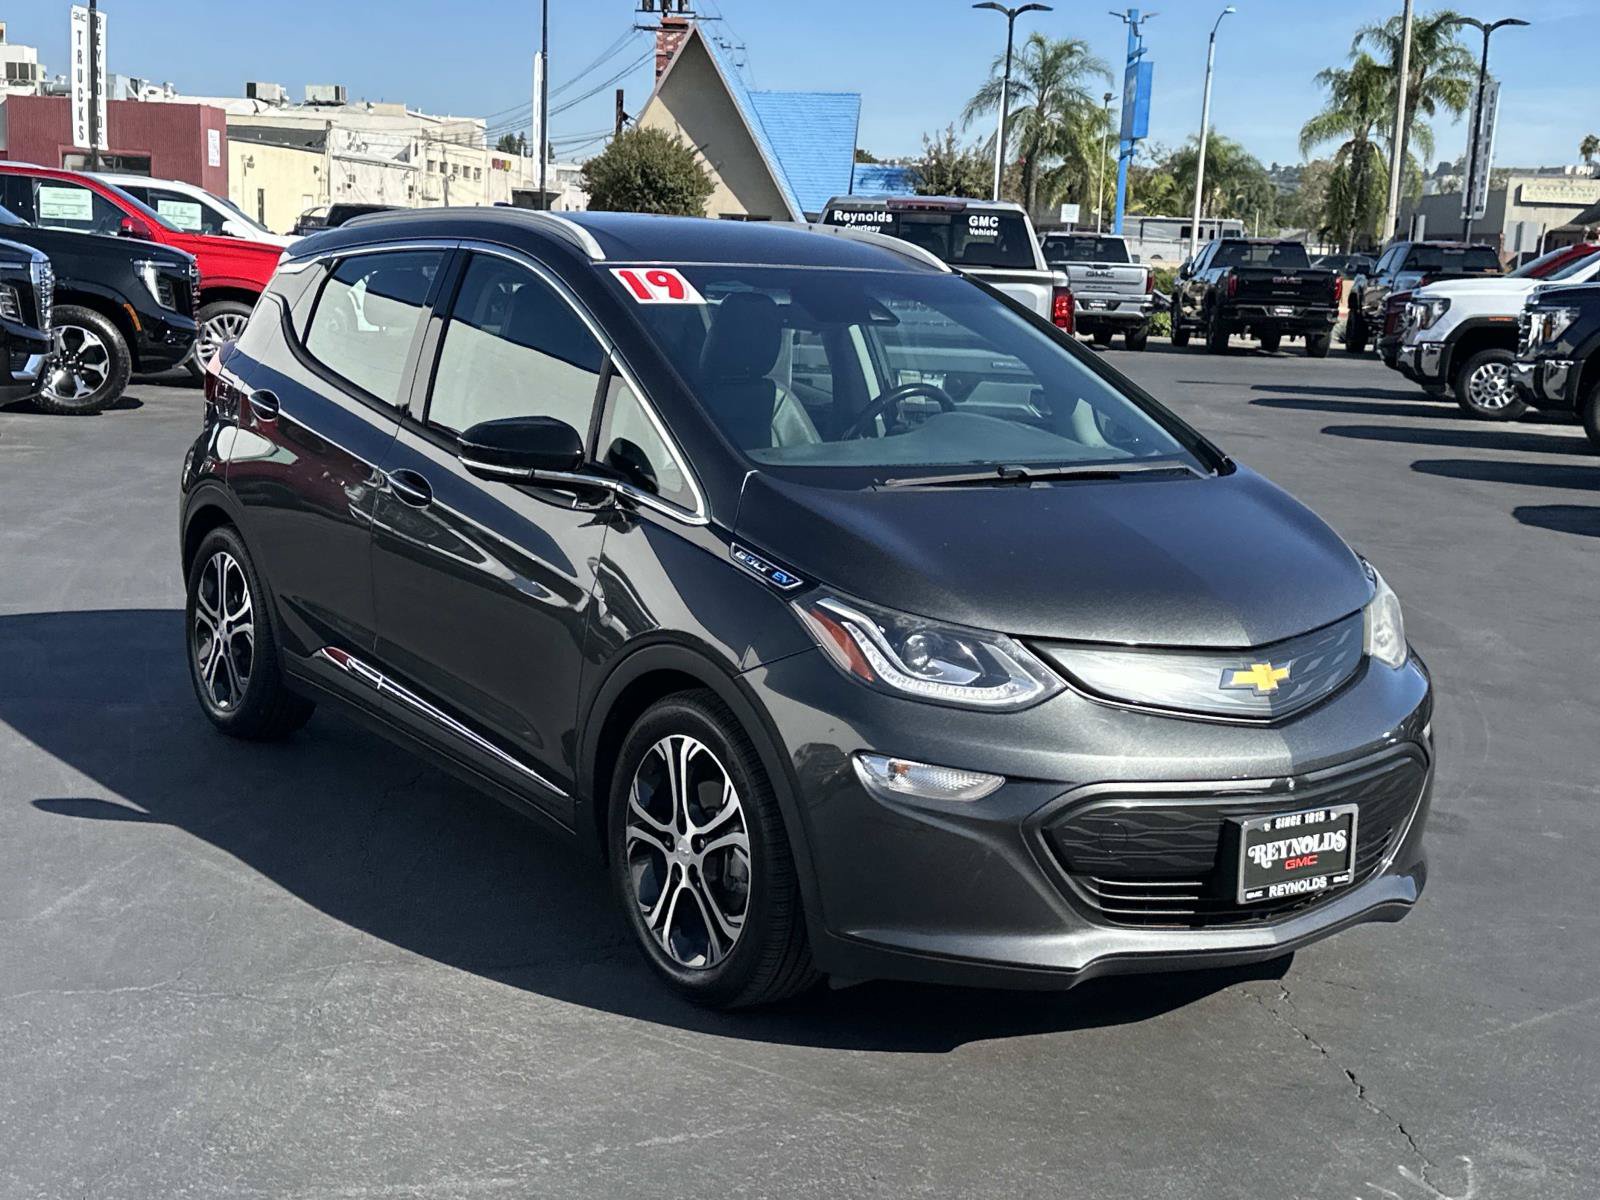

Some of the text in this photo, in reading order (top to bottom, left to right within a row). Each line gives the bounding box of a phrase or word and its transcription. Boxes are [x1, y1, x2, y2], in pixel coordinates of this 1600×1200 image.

[76, 30, 84, 141] TRUCKS
[833, 210, 893, 223] Reynolds
[968, 215, 999, 228] GMC
[844, 223, 881, 233] Courtesy
[969, 228, 998, 236] Vehicle
[618, 270, 686, 300] 19
[771, 571, 795, 584] EV
[1275, 814, 1302, 829] SINCE
[1248, 830, 1347, 868] REYNOLDS
[1285, 855, 1318, 869] GMC
[1269, 876, 1327, 897] REYNOLDS
